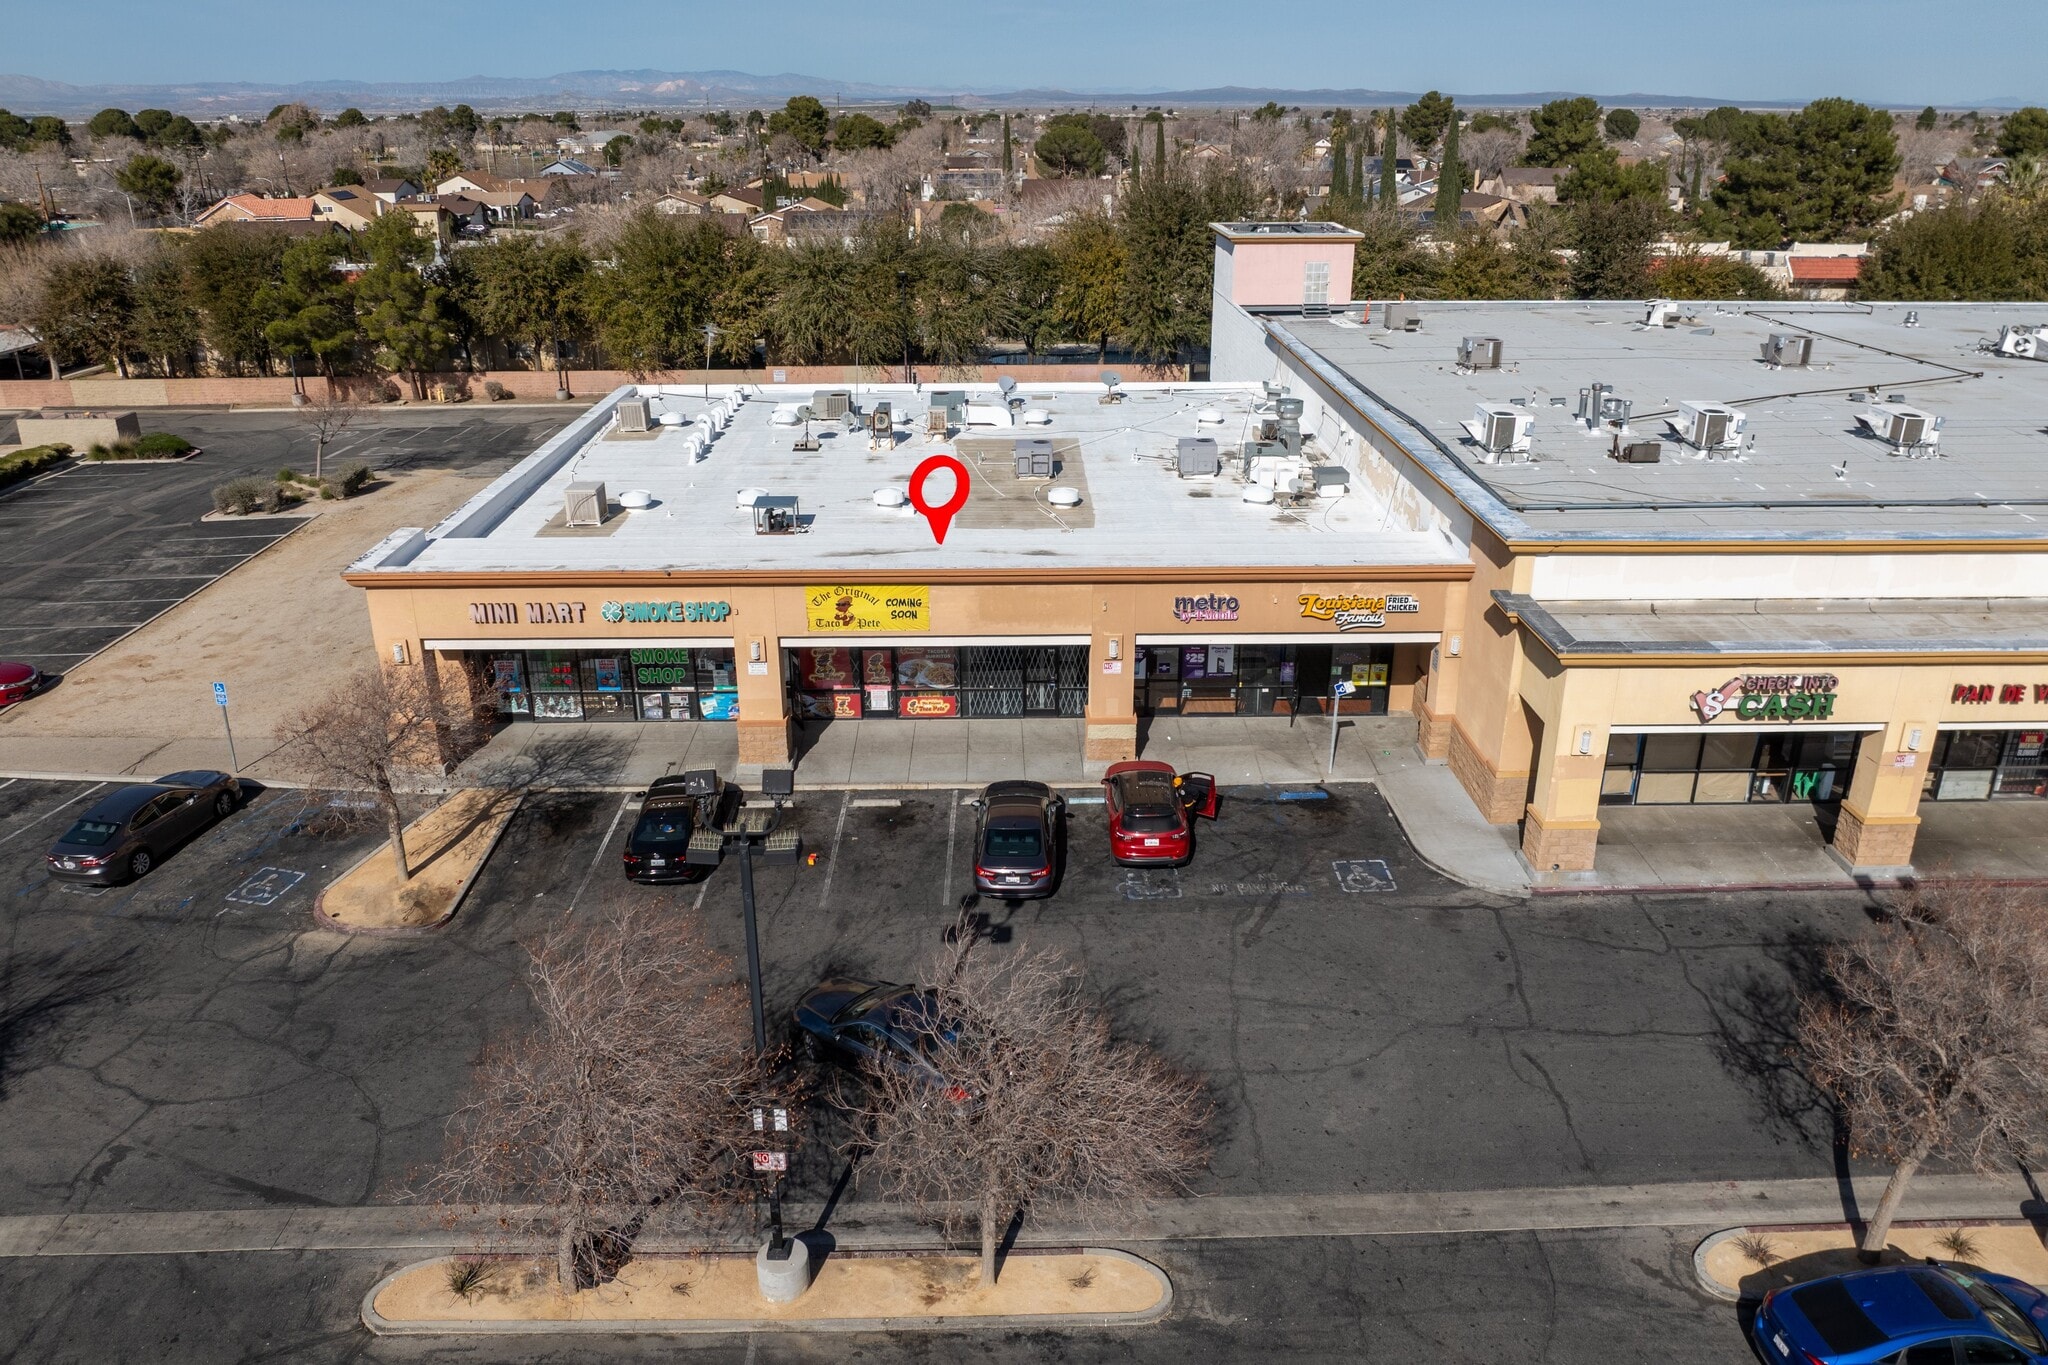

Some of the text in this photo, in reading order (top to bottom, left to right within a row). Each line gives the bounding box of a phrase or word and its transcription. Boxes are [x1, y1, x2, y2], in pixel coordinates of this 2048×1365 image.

[812, 586, 880, 606] The Original
[886, 597, 922, 608] COMING
[1174, 593, 1239, 610] metro
[1388, 596, 1409, 604] FRIED
[470, 602, 586, 623] MINI MART
[624, 601, 731, 622] SMOKE SHOP
[891, 609, 918, 620] SOON
[1298, 594, 1385, 620] Louisiana
[815, 617, 881, 629] Taco Pete
[1334, 611, 1386, 627] Famous
[630, 648, 689, 664] SMOKE
[1185, 653, 1205, 664] $25
[638, 668, 685, 684] SHOP
[1746, 676, 1840, 690] CHECK INTO
[1954, 685, 1995, 702] PAN
[2001, 685, 2026, 702] DE
